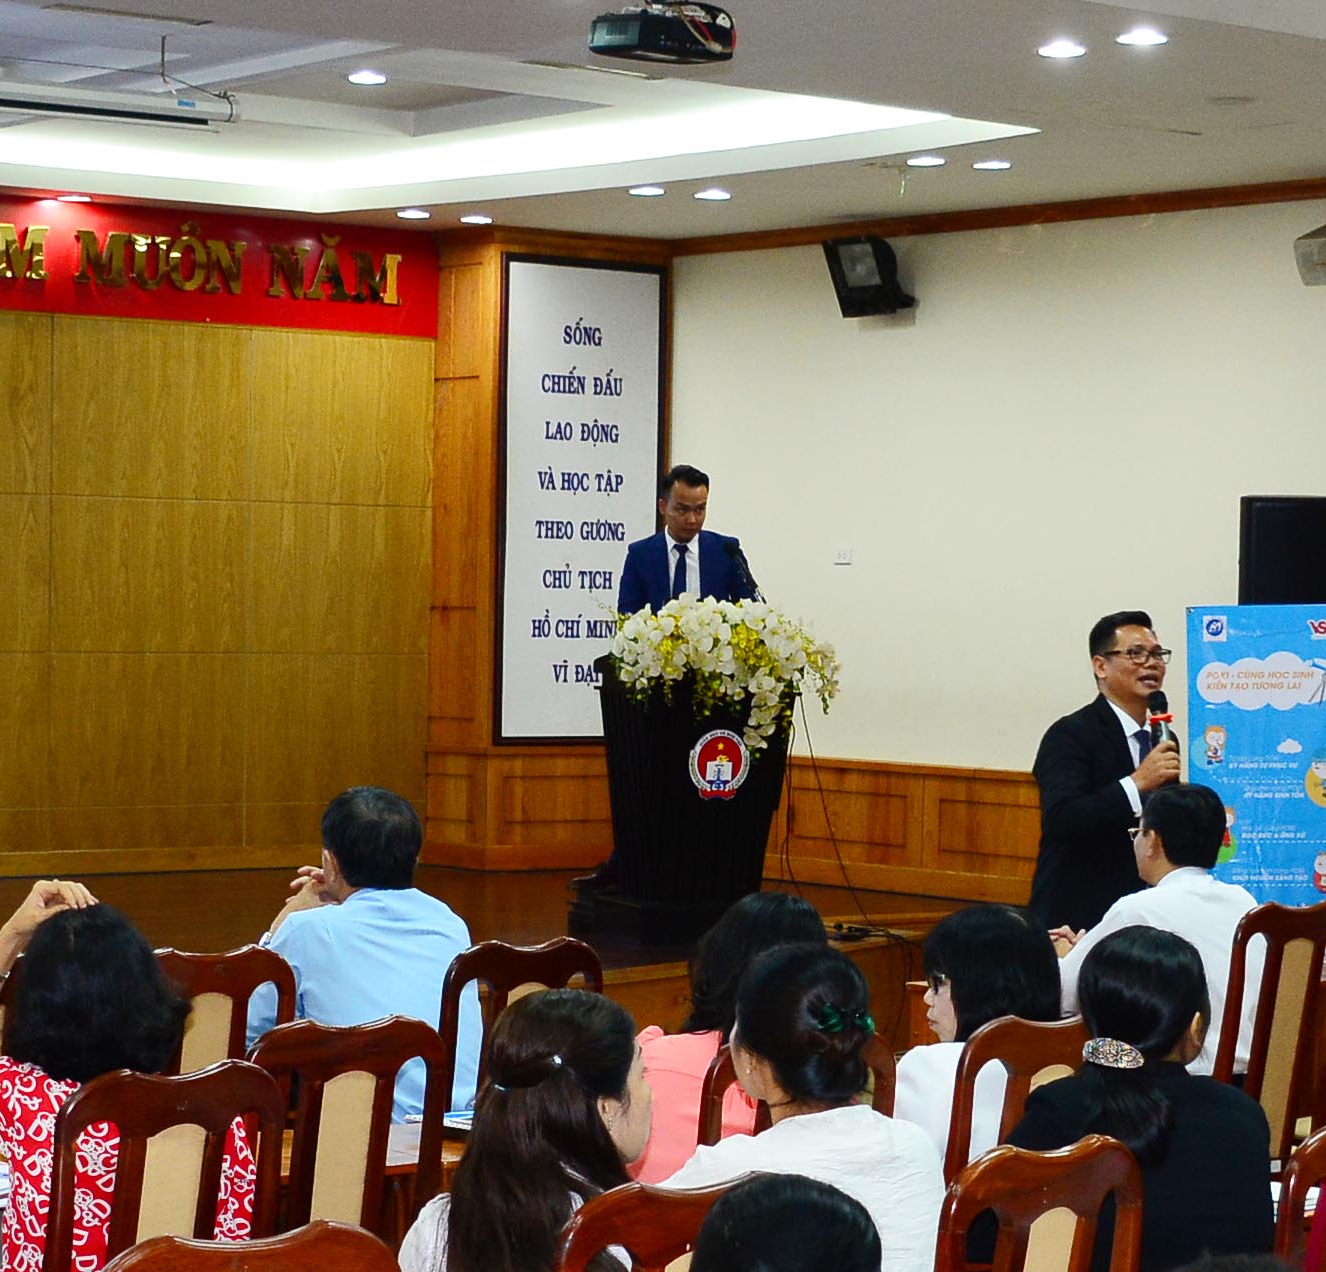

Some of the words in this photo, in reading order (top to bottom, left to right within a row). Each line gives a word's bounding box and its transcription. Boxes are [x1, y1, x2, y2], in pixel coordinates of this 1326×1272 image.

[74, 220, 248, 297] MUÔN
[267, 234, 403, 307] NĂM
[563, 318, 603, 348] SỐNG
[541, 365, 587, 396] CHIẾN
[593, 371, 624, 397] ĐẤU
[545, 421, 573, 442] LAO
[580, 418, 620, 449] ĐỘNG
[538, 468, 557, 491] VÀ
[560, 473, 590, 497] HỌC
[595, 469, 624, 498] TẬP
[535, 520, 574, 541] THEO
[580, 520, 626, 542] GƯƠNG
[542, 563, 573, 591] CHỦ
[578, 569, 613, 594] TỊCH
[531, 607, 551, 639] HỒ
[555, 614, 581, 639] CHÍ
[552, 659, 569, 684] VĨ
[1237, 670, 1265, 679] CÙNG
[1267, 671, 1290, 680] HỌC
[1292, 671, 1315, 679] SINH
[1287, 682, 1302, 690] LAI
